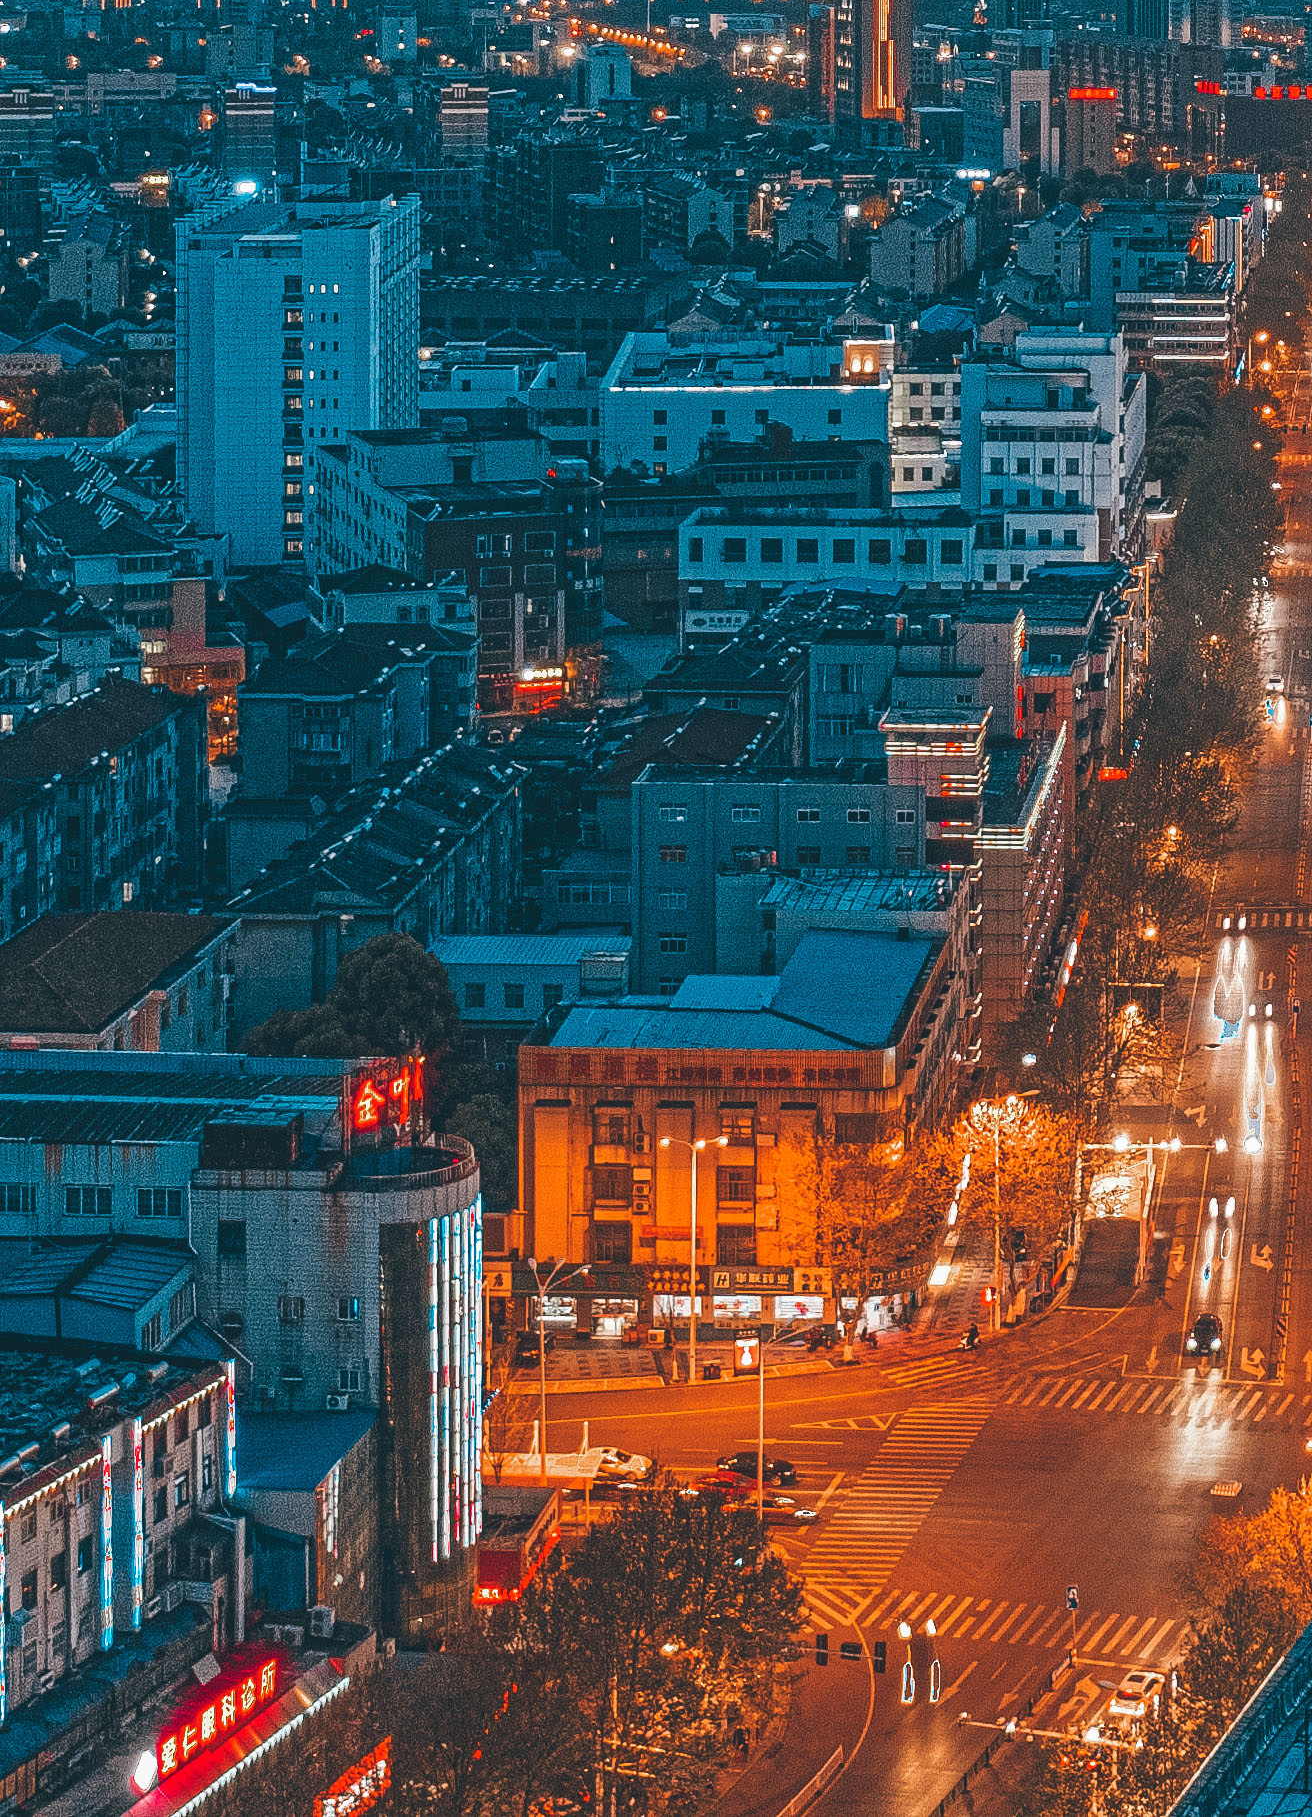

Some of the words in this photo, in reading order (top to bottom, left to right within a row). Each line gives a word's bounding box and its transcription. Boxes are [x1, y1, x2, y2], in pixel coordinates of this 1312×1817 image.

[161, 1661, 275, 1774] 爱仁眼科诊所
